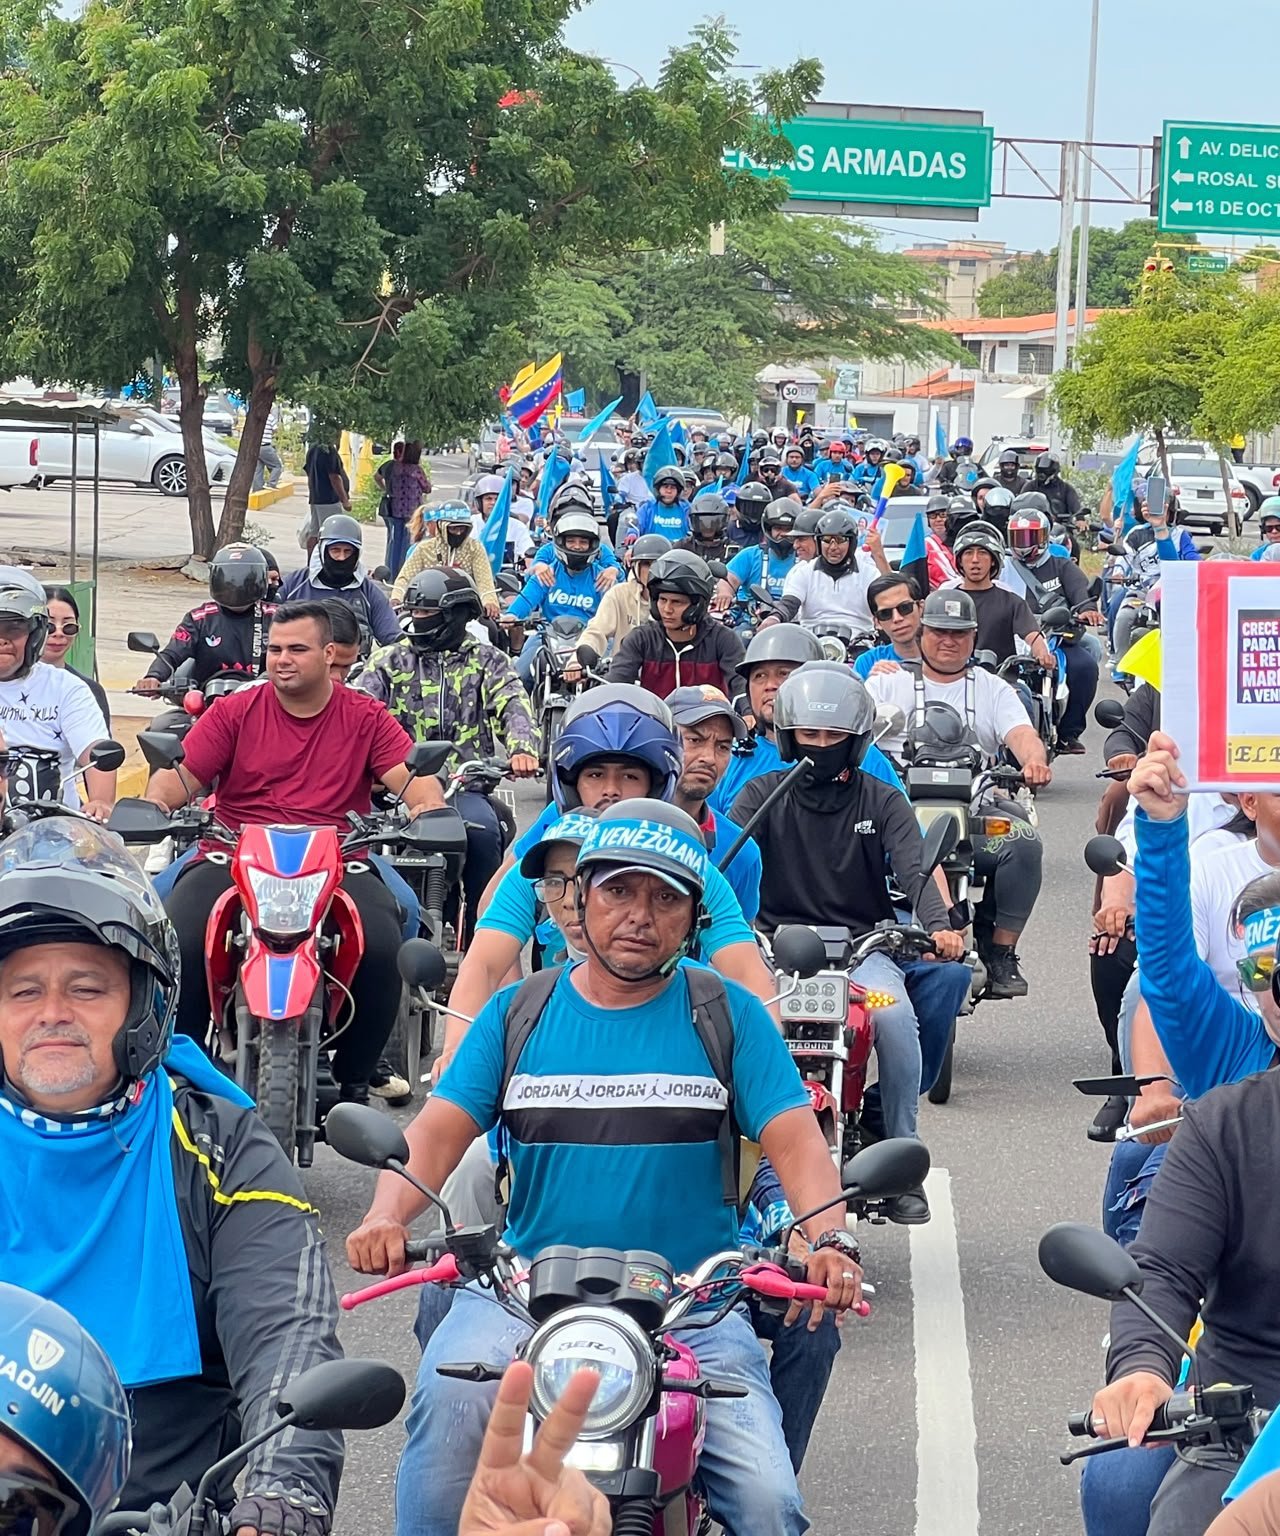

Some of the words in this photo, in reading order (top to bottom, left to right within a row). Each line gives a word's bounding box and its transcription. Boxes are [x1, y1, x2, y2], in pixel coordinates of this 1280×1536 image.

[1199, 141, 1224, 156] AV.
[822, 146, 967, 179] ARMADAS
[1197, 171, 1258, 188] ROSAL
[1195, 199, 1214, 214] 18
[1220, 201, 1243, 216] DE
[785, 387, 798, 396] 30
[548, 588, 594, 609] Vente
[1242, 621, 1279, 636] CRECE
[1242, 637, 1276, 652] PARA
[1242, 652, 1257, 668] EL
[1242, 689, 1252, 703] A
[788, 1042, 829, 1050] HAOJIN
[517, 1084, 571, 1100] JORDAN
[585, 1083, 646, 1098] JORDAN
[663, 1083, 722, 1100] JORDAN
